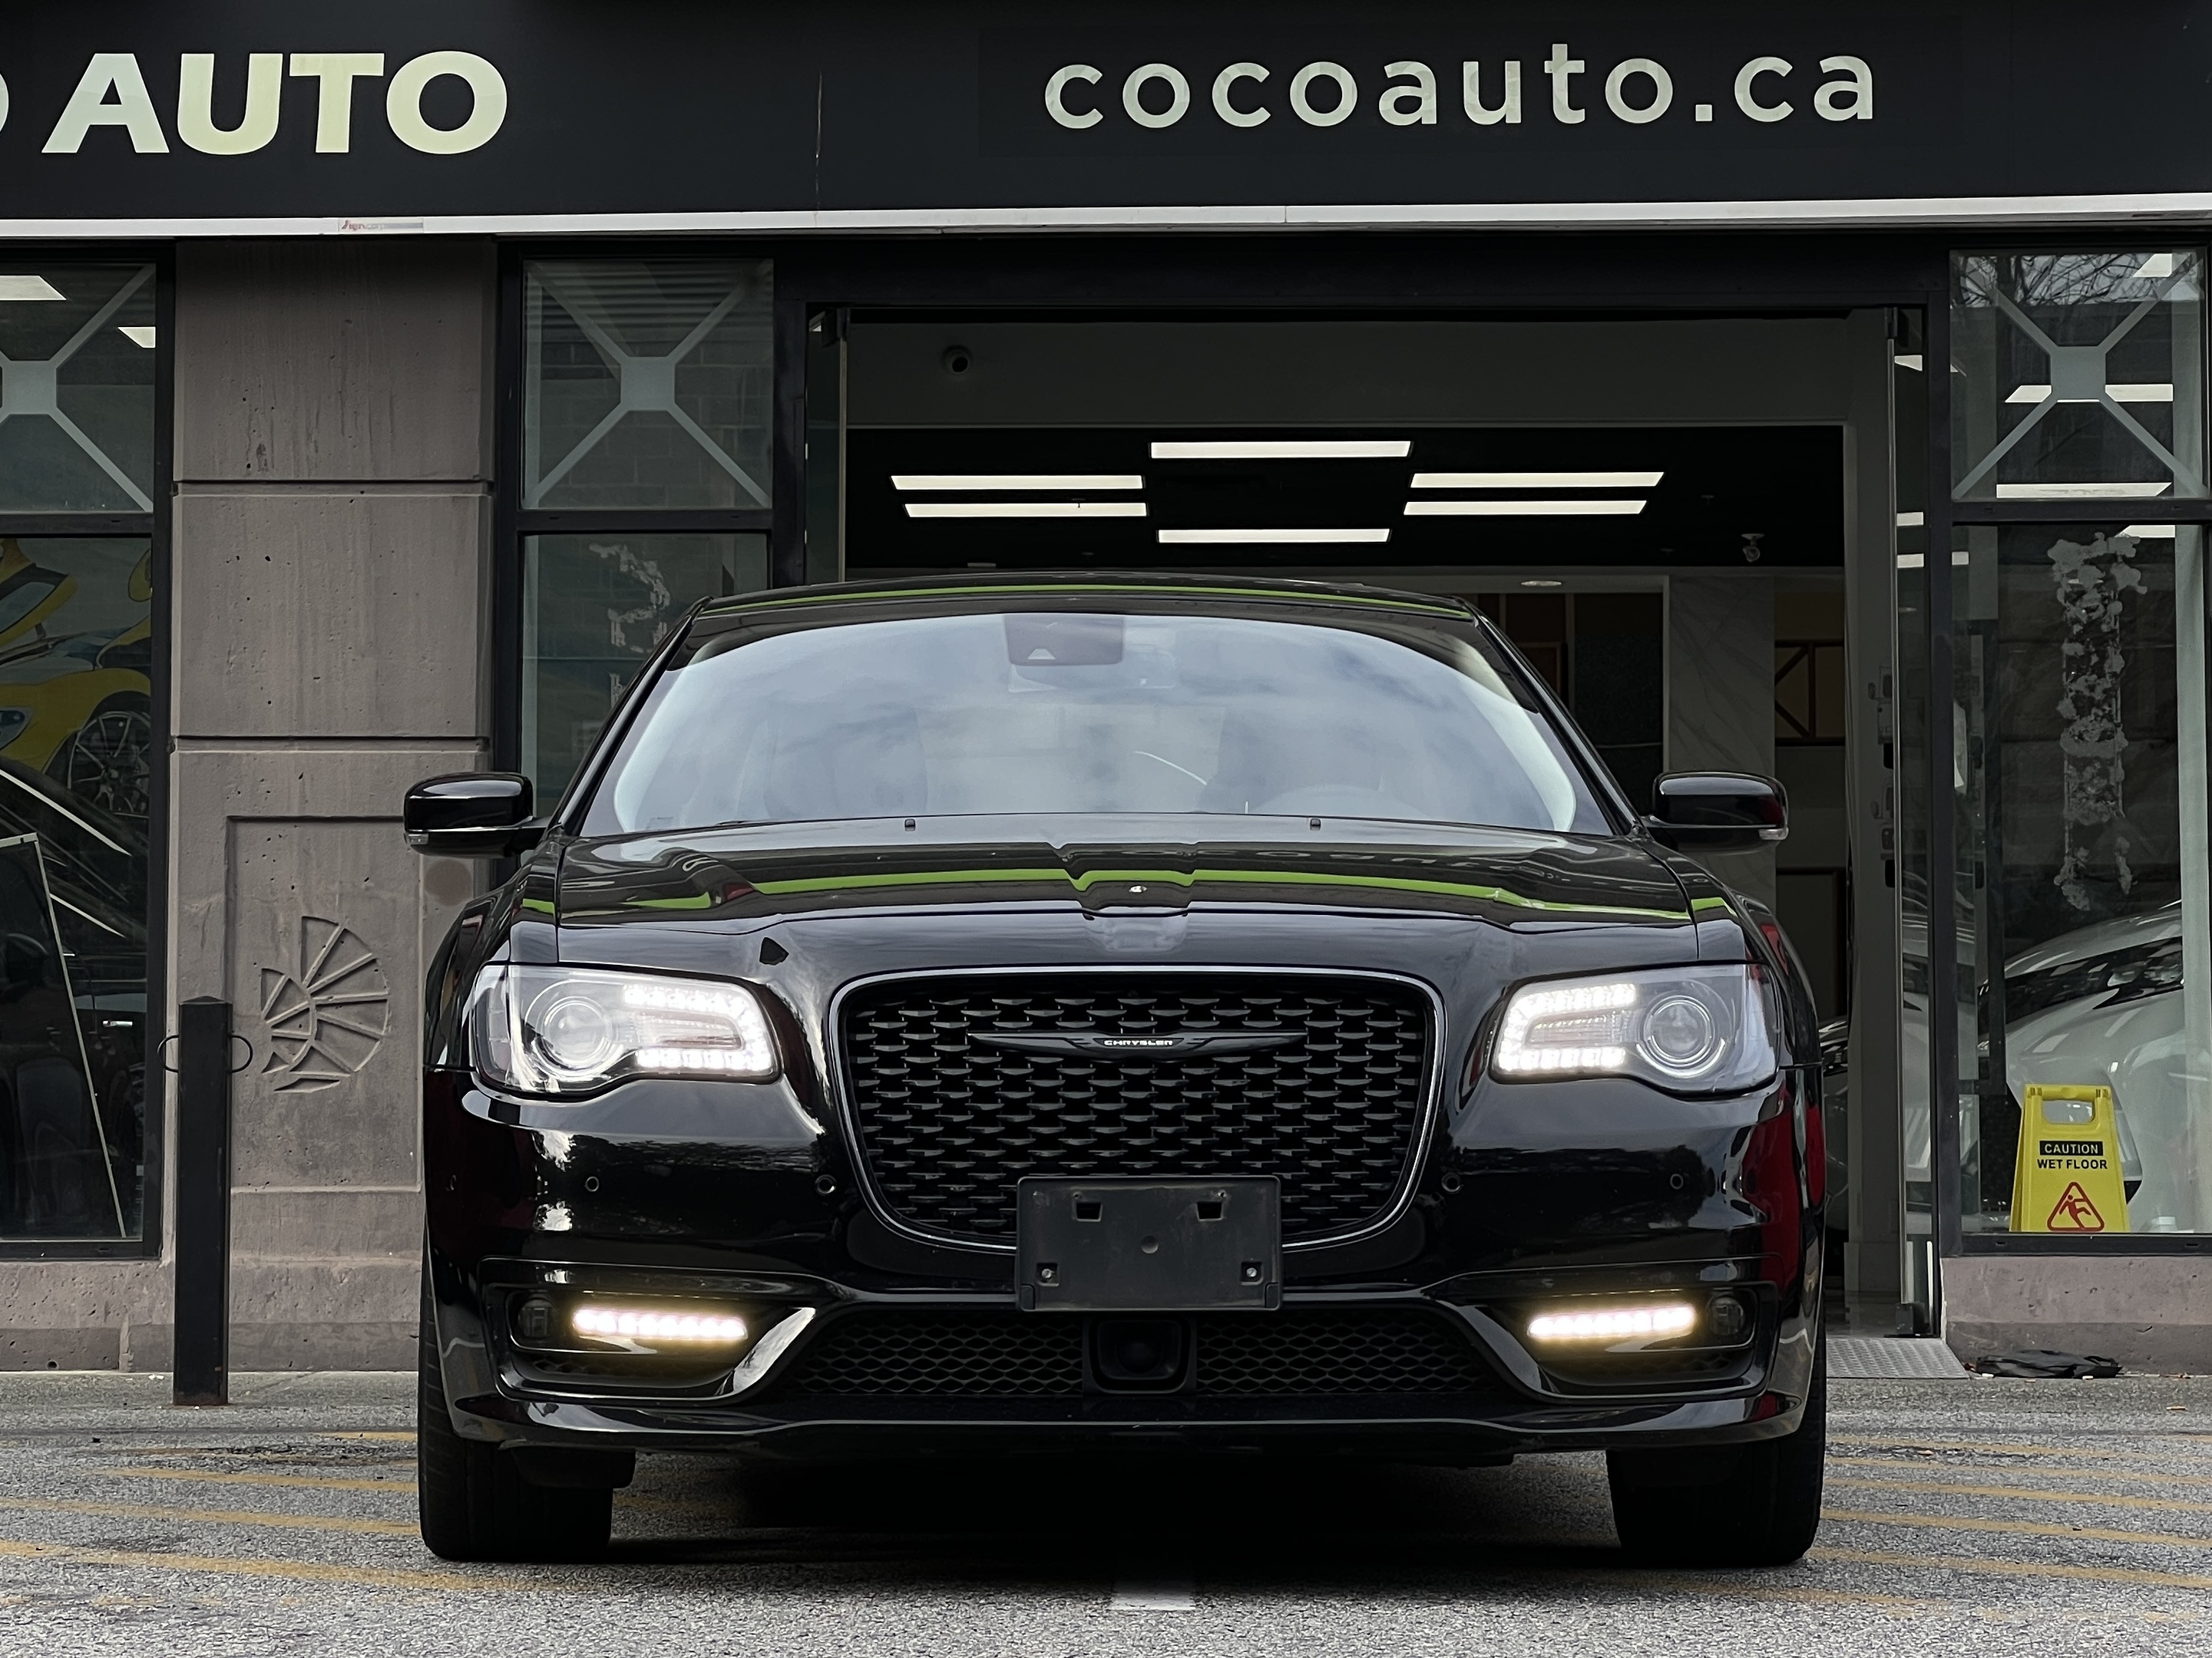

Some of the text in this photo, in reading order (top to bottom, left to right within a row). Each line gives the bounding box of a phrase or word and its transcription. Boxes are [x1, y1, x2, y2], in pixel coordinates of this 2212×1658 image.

[41, 51, 508, 156] AUTO
[1044, 43, 1873, 129] cocoauto.ca
[2037, 1158, 2108, 1170] WET FLOOR
[2044, 1143, 2098, 1154] CAUTION
